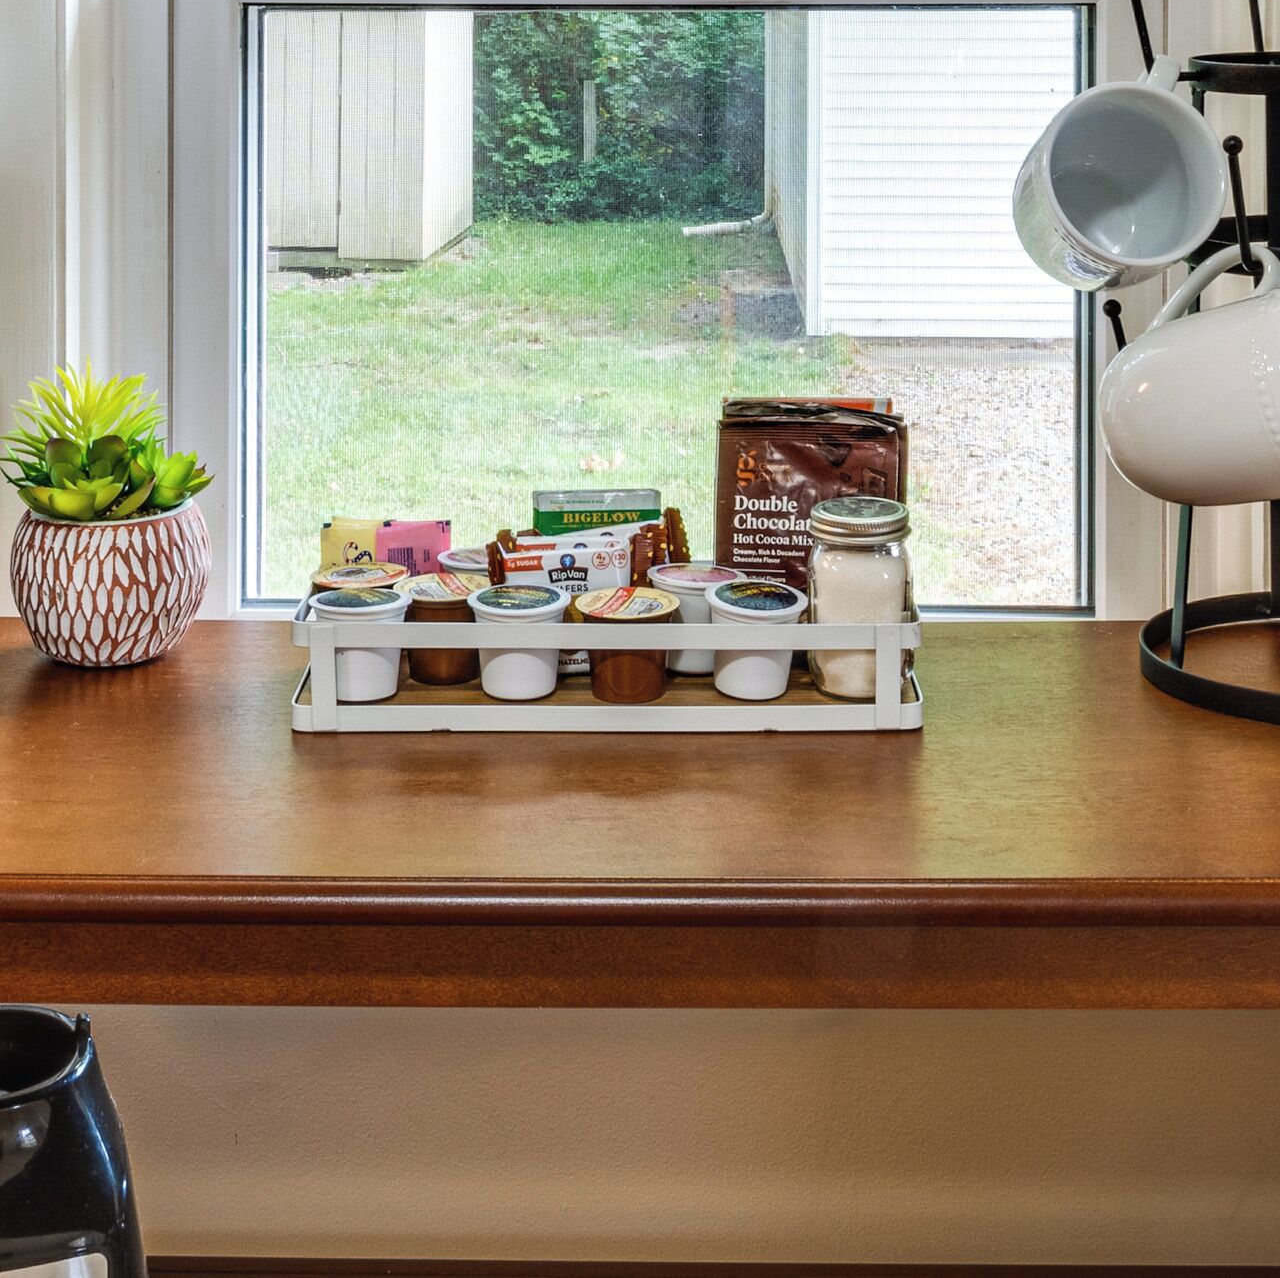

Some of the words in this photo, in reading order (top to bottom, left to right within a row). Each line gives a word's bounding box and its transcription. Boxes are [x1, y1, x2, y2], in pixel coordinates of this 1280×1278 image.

[734, 495, 798, 513] Double
[563, 511, 641, 523] BIGELOW
[733, 513, 811, 532] Chocolat
[733, 533, 754, 544] Hot
[755, 534, 790, 545] Cocoa
[791, 535, 814, 546] Mix
[733, 548, 757, 556] Creamy,
[776, 549, 805, 557] Decadent
[516, 559, 538, 567] SUGAR
